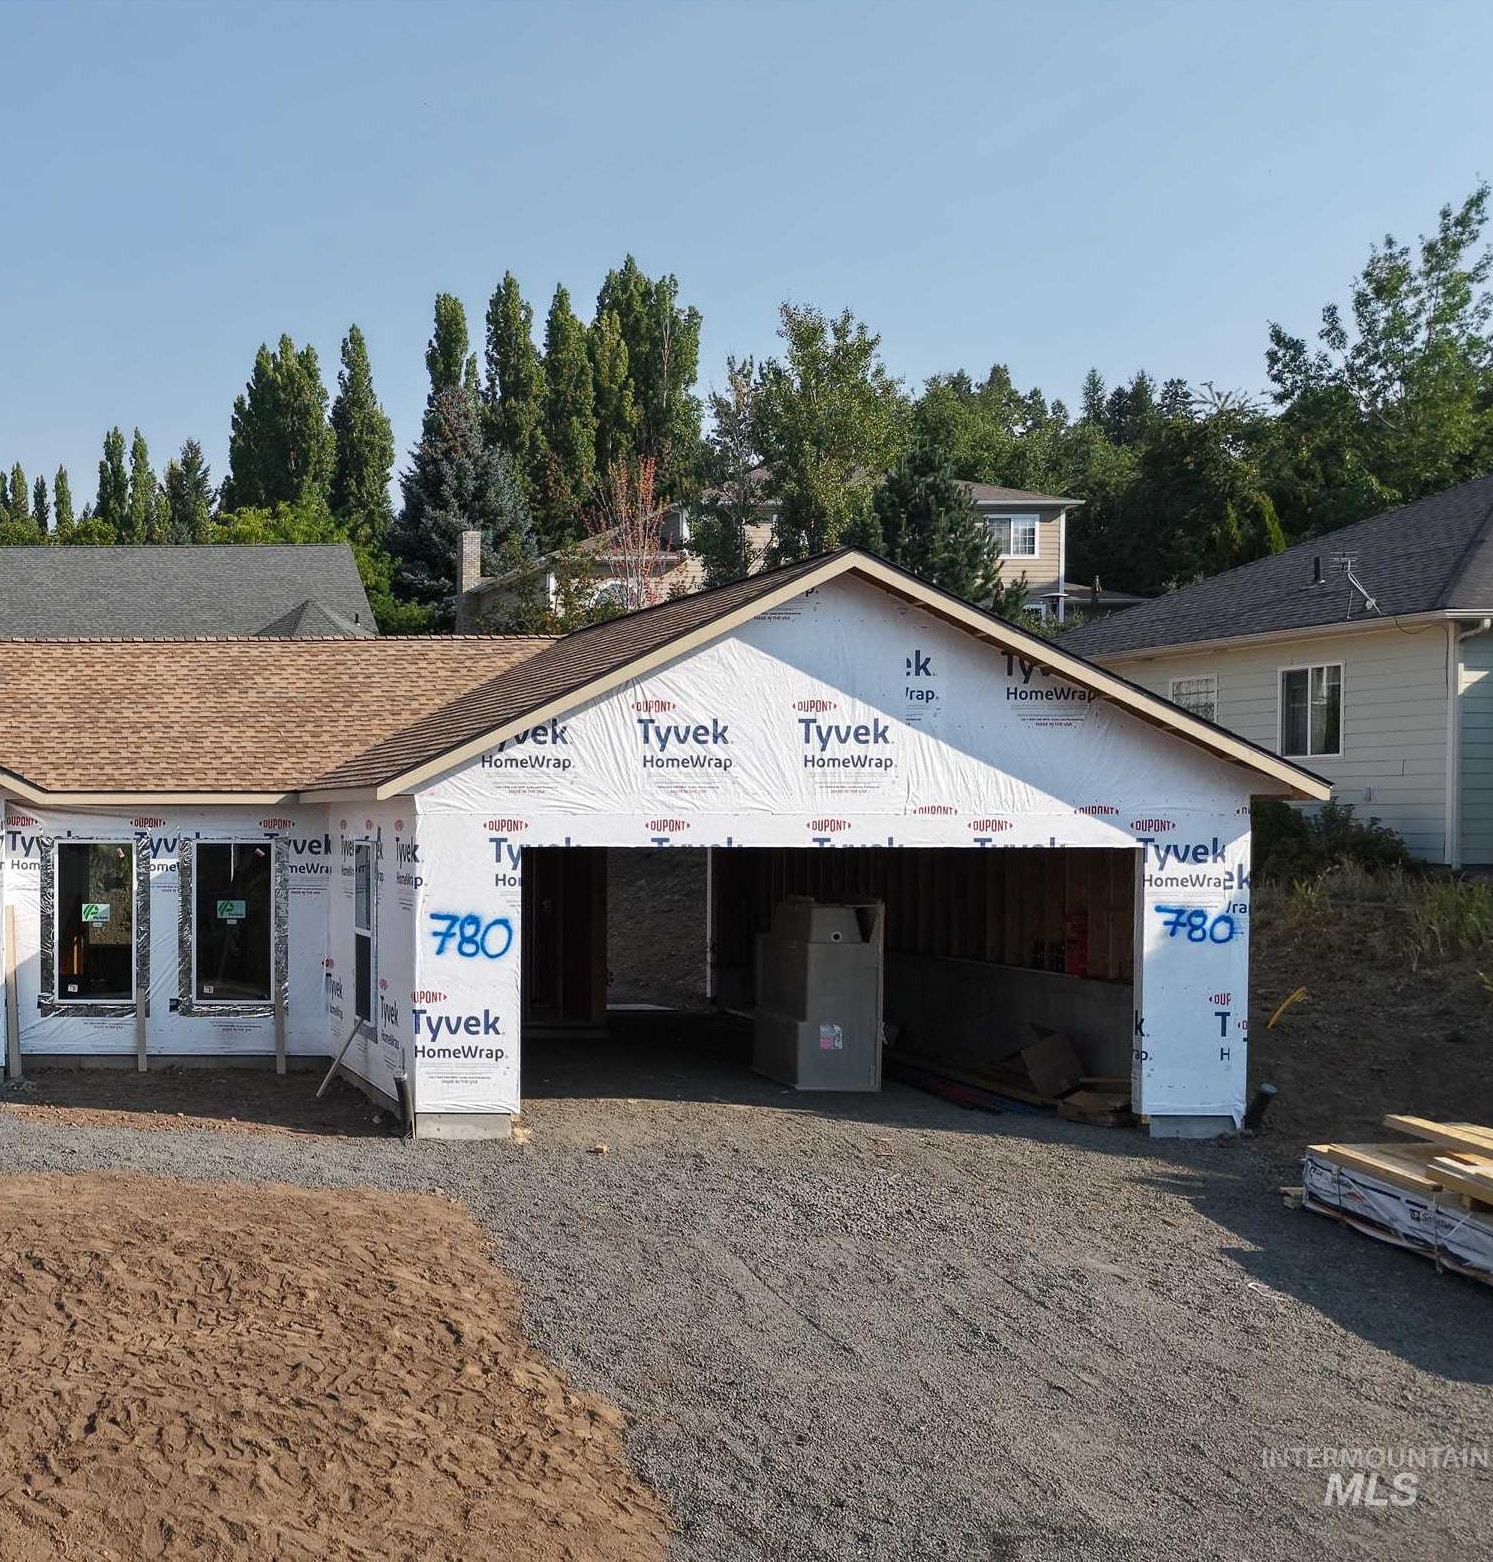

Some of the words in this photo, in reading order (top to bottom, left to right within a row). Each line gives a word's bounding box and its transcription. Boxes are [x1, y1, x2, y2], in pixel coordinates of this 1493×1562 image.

[1006, 687, 1096, 703] HomeWrap
[636, 702, 671, 713] DUPONT
[797, 700, 832, 712] DUPONT
[637, 718, 729, 751] Tyvek
[799, 718, 890, 751] Tyvek
[481, 755, 571, 771] HomeWrap
[643, 755, 733, 770] HomeWrap
[804, 755, 893, 771] HomeWrap
[134, 819, 162, 827] DUPONT
[263, 818, 291, 828] DUPONT
[489, 820, 524, 831] DUPONT
[651, 819, 685, 832] DUPONT
[812, 819, 847, 832] DUPONT
[973, 820, 1009, 830] DUPONT
[1135, 820, 1171, 832] DUPONT
[1136, 837, 1226, 871] Tyvek
[1154, 905, 1235, 943] 780
[430, 913, 513, 958] 780
[412, 1009, 500, 1042] Tyvek
[414, 1046, 504, 1061] HomeWrap
